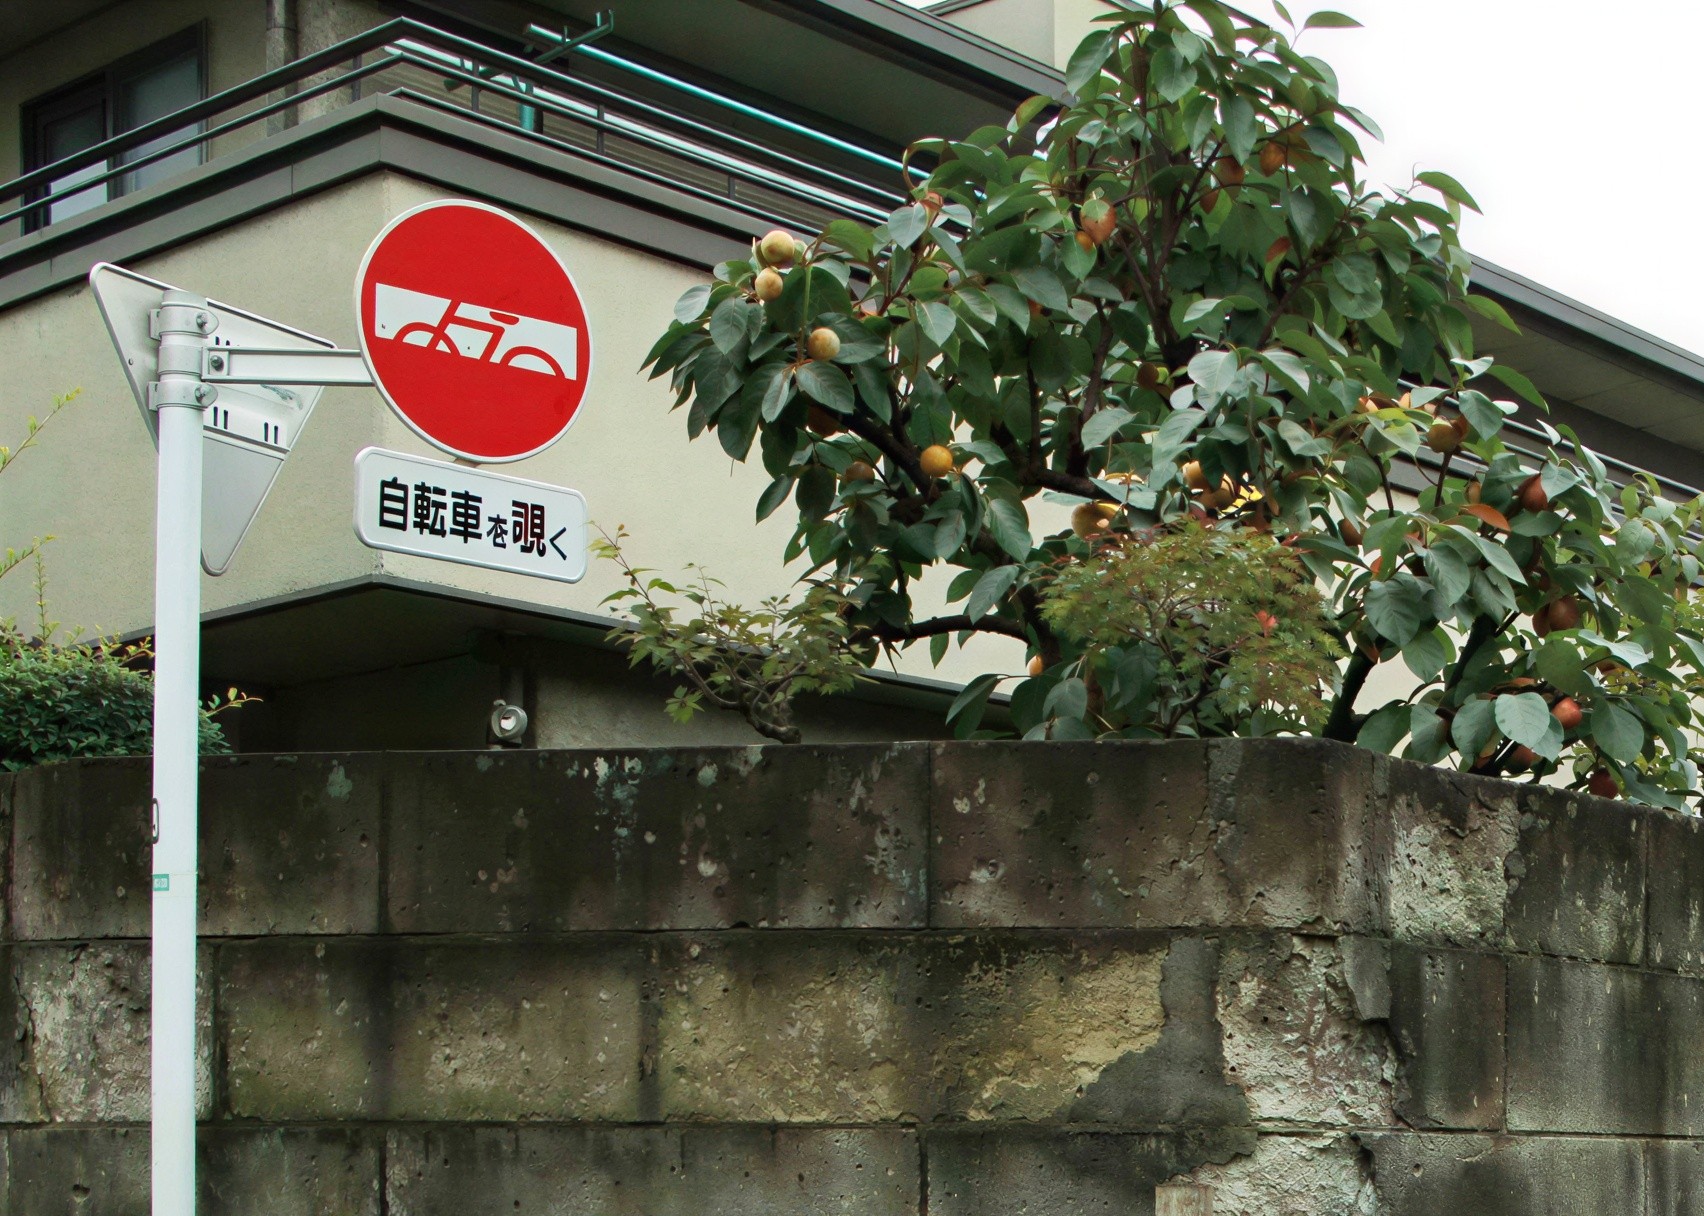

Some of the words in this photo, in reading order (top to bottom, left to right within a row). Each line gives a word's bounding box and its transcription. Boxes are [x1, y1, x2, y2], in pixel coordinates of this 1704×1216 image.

[378, 476, 567, 561] 自転車を覗く
